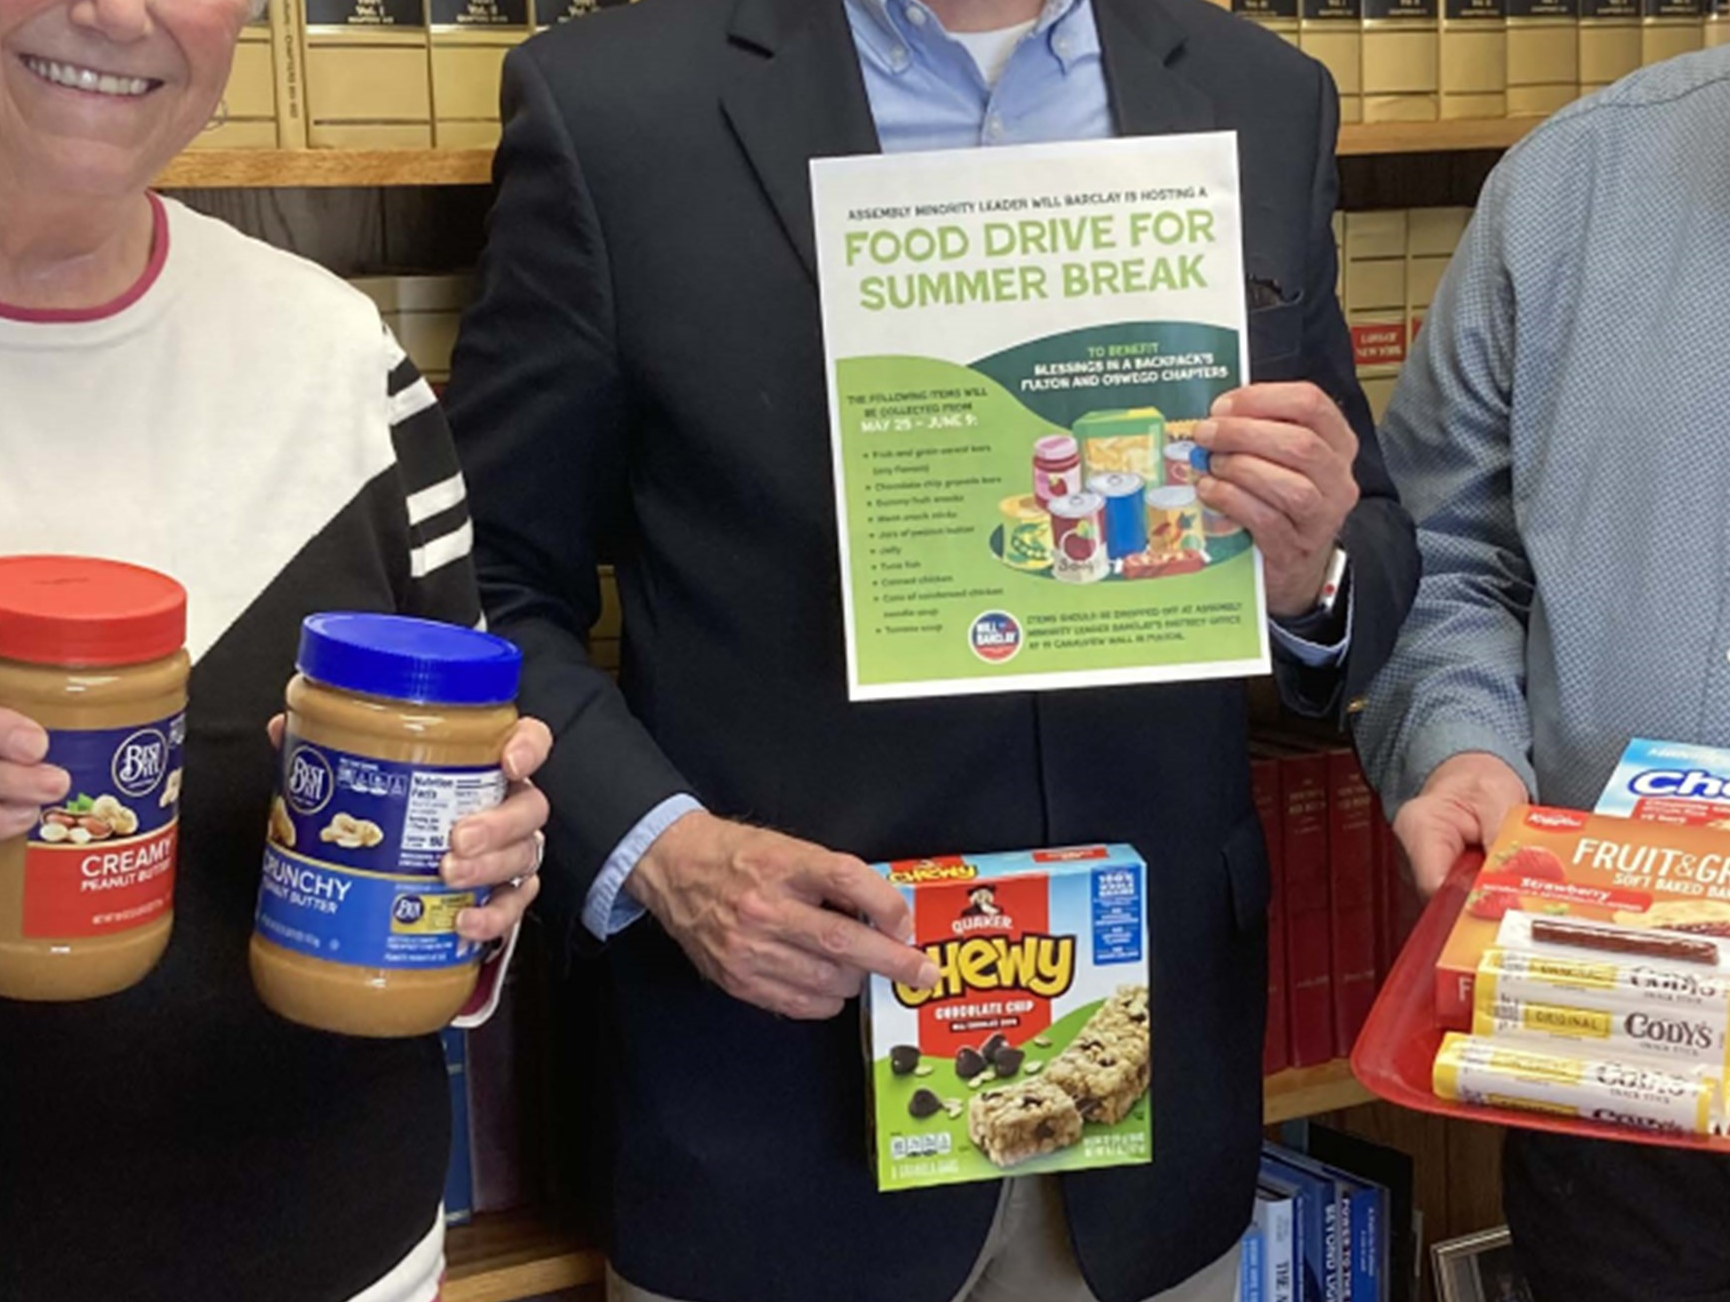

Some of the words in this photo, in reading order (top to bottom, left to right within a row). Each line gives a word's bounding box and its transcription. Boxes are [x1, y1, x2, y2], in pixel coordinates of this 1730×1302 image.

[848, 206, 910, 221] ASSEMBLY
[915, 202, 975, 216] MINORITY
[978, 198, 1028, 212] LEADER
[1032, 197, 1062, 209] WILL
[1065, 192, 1122, 206] BARCLAY
[1124, 191, 1136, 203] IS
[1140, 188, 1193, 202] HOSTING
[1196, 187, 1207, 198] A
[844, 226, 970, 267] FOOD
[984, 215, 1117, 257] DRIVE
[1130, 209, 1215, 246] FOR
[860, 266, 1048, 311] SUMMER
[1061, 254, 1207, 298] BREAK
[1088, 346, 1105, 358] TO
[1108, 343, 1159, 357] BENEFIT
[1034, 362, 1103, 375] BLESSINGS
[1107, 360, 1118, 371] IN
[1122, 359, 1132, 370] A
[1134, 354, 1214, 370] BACKPACK'S
[1022, 378, 1070, 392] FULTON
[1073, 375, 1099, 388] AND
[1103, 372, 1159, 386] OSWEGO
[1162, 365, 1228, 382] CHAPTERS
[847, 395, 866, 404] THE
[869, 392, 927, 403] FOLLOWING
[931, 390, 961, 399] ITEMS
[965, 388, 987, 397] WILL
[864, 408, 877, 417] BE
[881, 405, 940, 417] COLLECTED
[942, 403, 972, 413] FROM
[860, 420, 891, 433] MAY
[927, 416, 962, 429] JUNE
[412, 787, 437, 799] Facts
[414, 776, 453, 789] Nutrition
[81, 839, 170, 877] CREAMY
[81, 874, 136, 892] PEANUT
[263, 850, 351, 902] CRUNCHY
[1612, 872, 1650, 888] SOFT
[1655, 878, 1703, 895] BAKED
[1521, 877, 1611, 901] Strawberry
[291, 892, 337, 914] BUTTER
[952, 915, 1013, 934] QUAKER
[935, 1002, 1003, 1020] CHOCOLATE
[1005, 1000, 1034, 1014] CHIP
[1535, 1011, 1599, 1031] ORIGINAL
[1342, 1199, 1350, 1246] POWER
[1325, 1204, 1338, 1270] BEYOND
[1343, 1250, 1351, 1268] TO
[1275, 1260, 1289, 1291] THE
